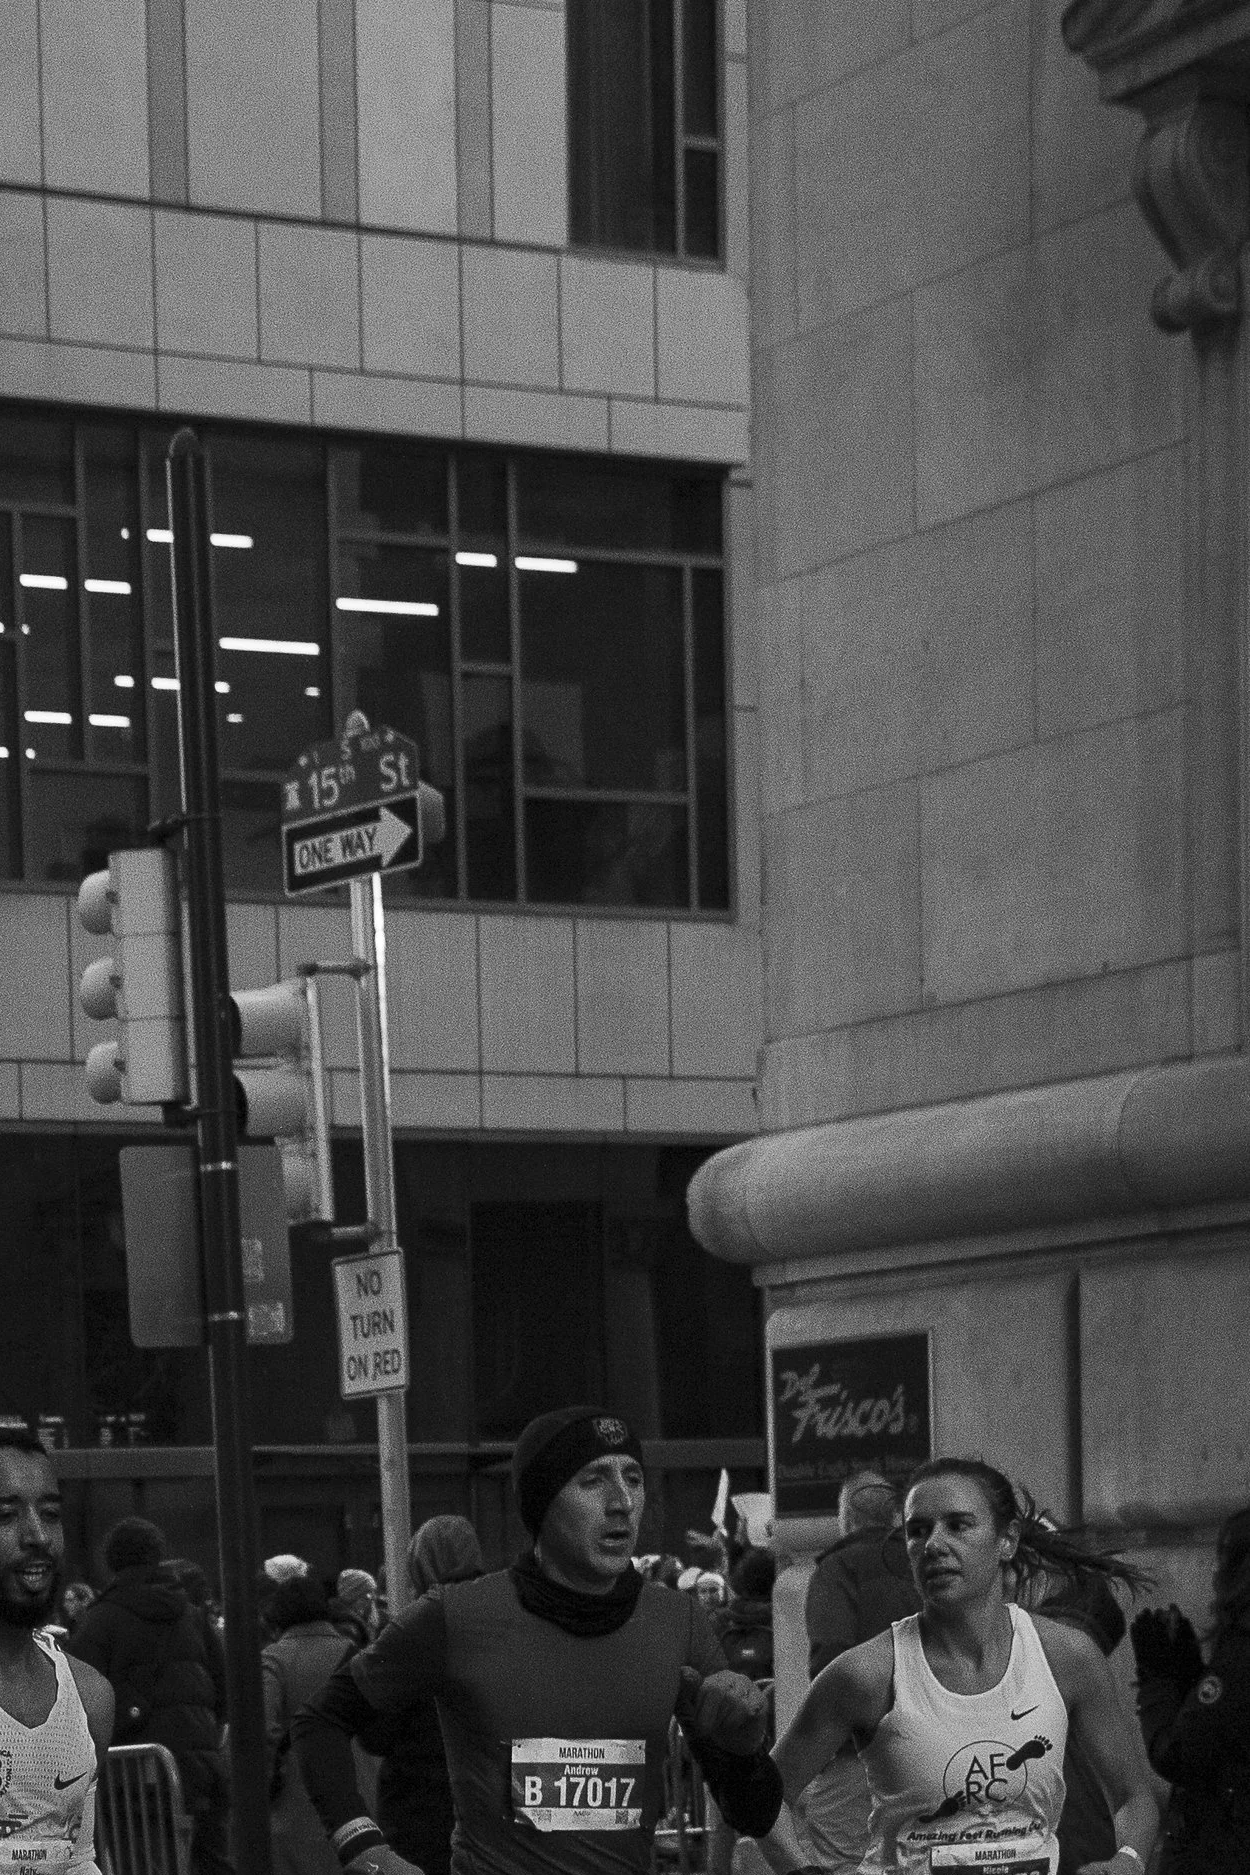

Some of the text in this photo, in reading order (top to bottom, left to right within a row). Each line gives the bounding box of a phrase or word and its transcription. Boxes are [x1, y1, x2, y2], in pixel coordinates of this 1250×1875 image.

[307, 751, 411, 811] 15th St
[300, 826, 377, 870] ONE WAY
[356, 1269, 383, 1298] NO
[350, 1308, 395, 1340] TURN
[346, 1349, 400, 1381] ON RED
[778, 1363, 821, 1403] Del
[791, 1383, 906, 1443] Frisco's
[558, 1746, 605, 1760] MARATHON
[564, 1764, 600, 1776] Andrew
[966, 1754, 1006, 1782] AF
[524, 1776, 637, 1808] B 17017
[966, 1778, 1008, 1804] RC
[907, 1830, 956, 1844] Amazing
[960, 1830, 983, 1840] Feet
[12, 1849, 48, 1861] MARATHON
[975, 1850, 1017, 1862] MARATHON
